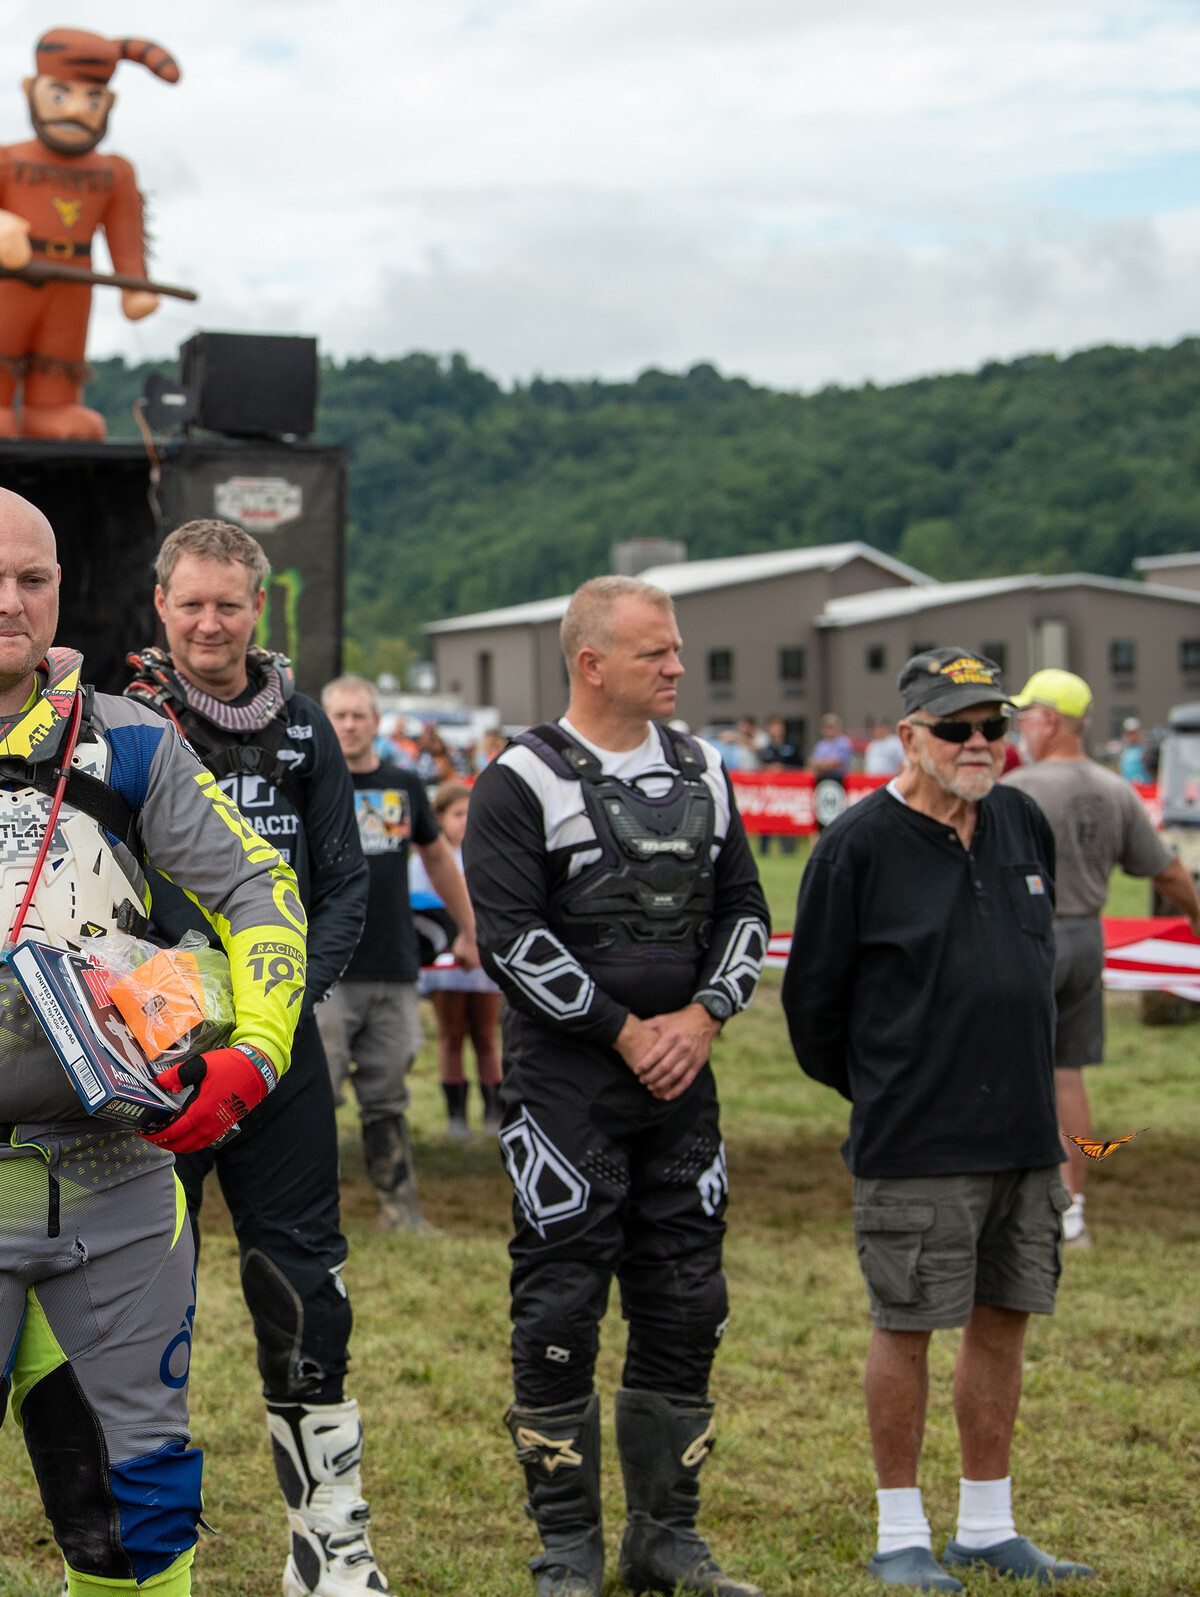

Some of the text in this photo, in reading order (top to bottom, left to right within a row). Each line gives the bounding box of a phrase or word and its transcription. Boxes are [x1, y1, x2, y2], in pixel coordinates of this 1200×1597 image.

[257, 943, 303, 962] RACING
[35, 971, 52, 999] UNITED
[50, 999, 66, 1026] STATES
[64, 1026, 76, 1045] FLAG
